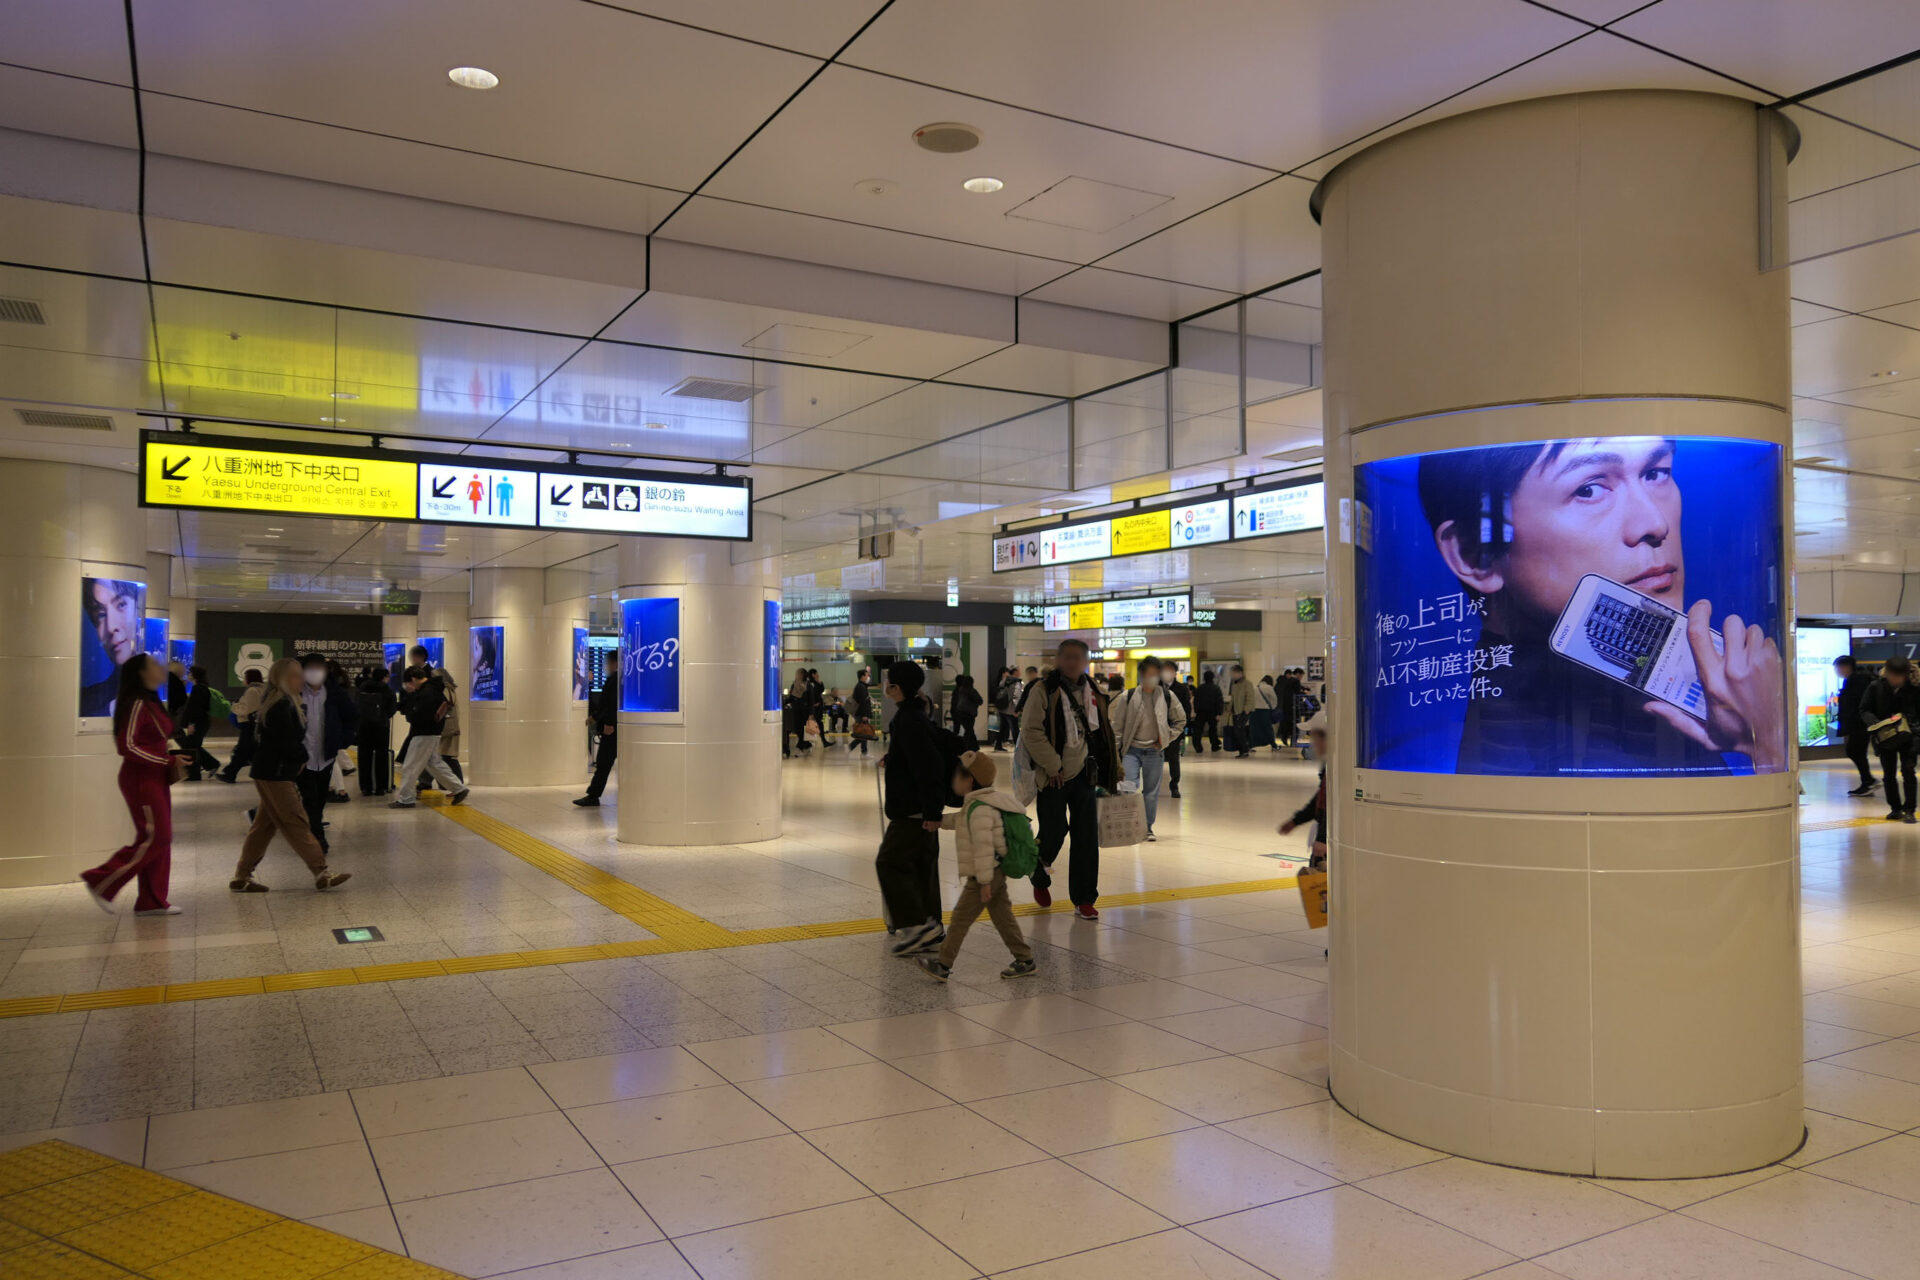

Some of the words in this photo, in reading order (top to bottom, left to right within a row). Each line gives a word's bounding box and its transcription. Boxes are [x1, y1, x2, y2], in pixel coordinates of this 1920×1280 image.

[202, 455, 360, 482] 八重洲地下中央口
[201, 489, 293, 504] 八重洲地下中央出口
[202, 476, 241, 488] Yaesu
[245, 479, 322, 496] Underground
[326, 484, 367, 496] Central
[370, 487, 391, 498] Exit
[644, 486, 686, 502] 銀の鈴
[695, 504, 724, 517] Waiting
[726, 508, 745, 517] Area
[1375, 644, 1514, 688] AI不動産投資
[1409, 676, 1502, 707] していた件。
